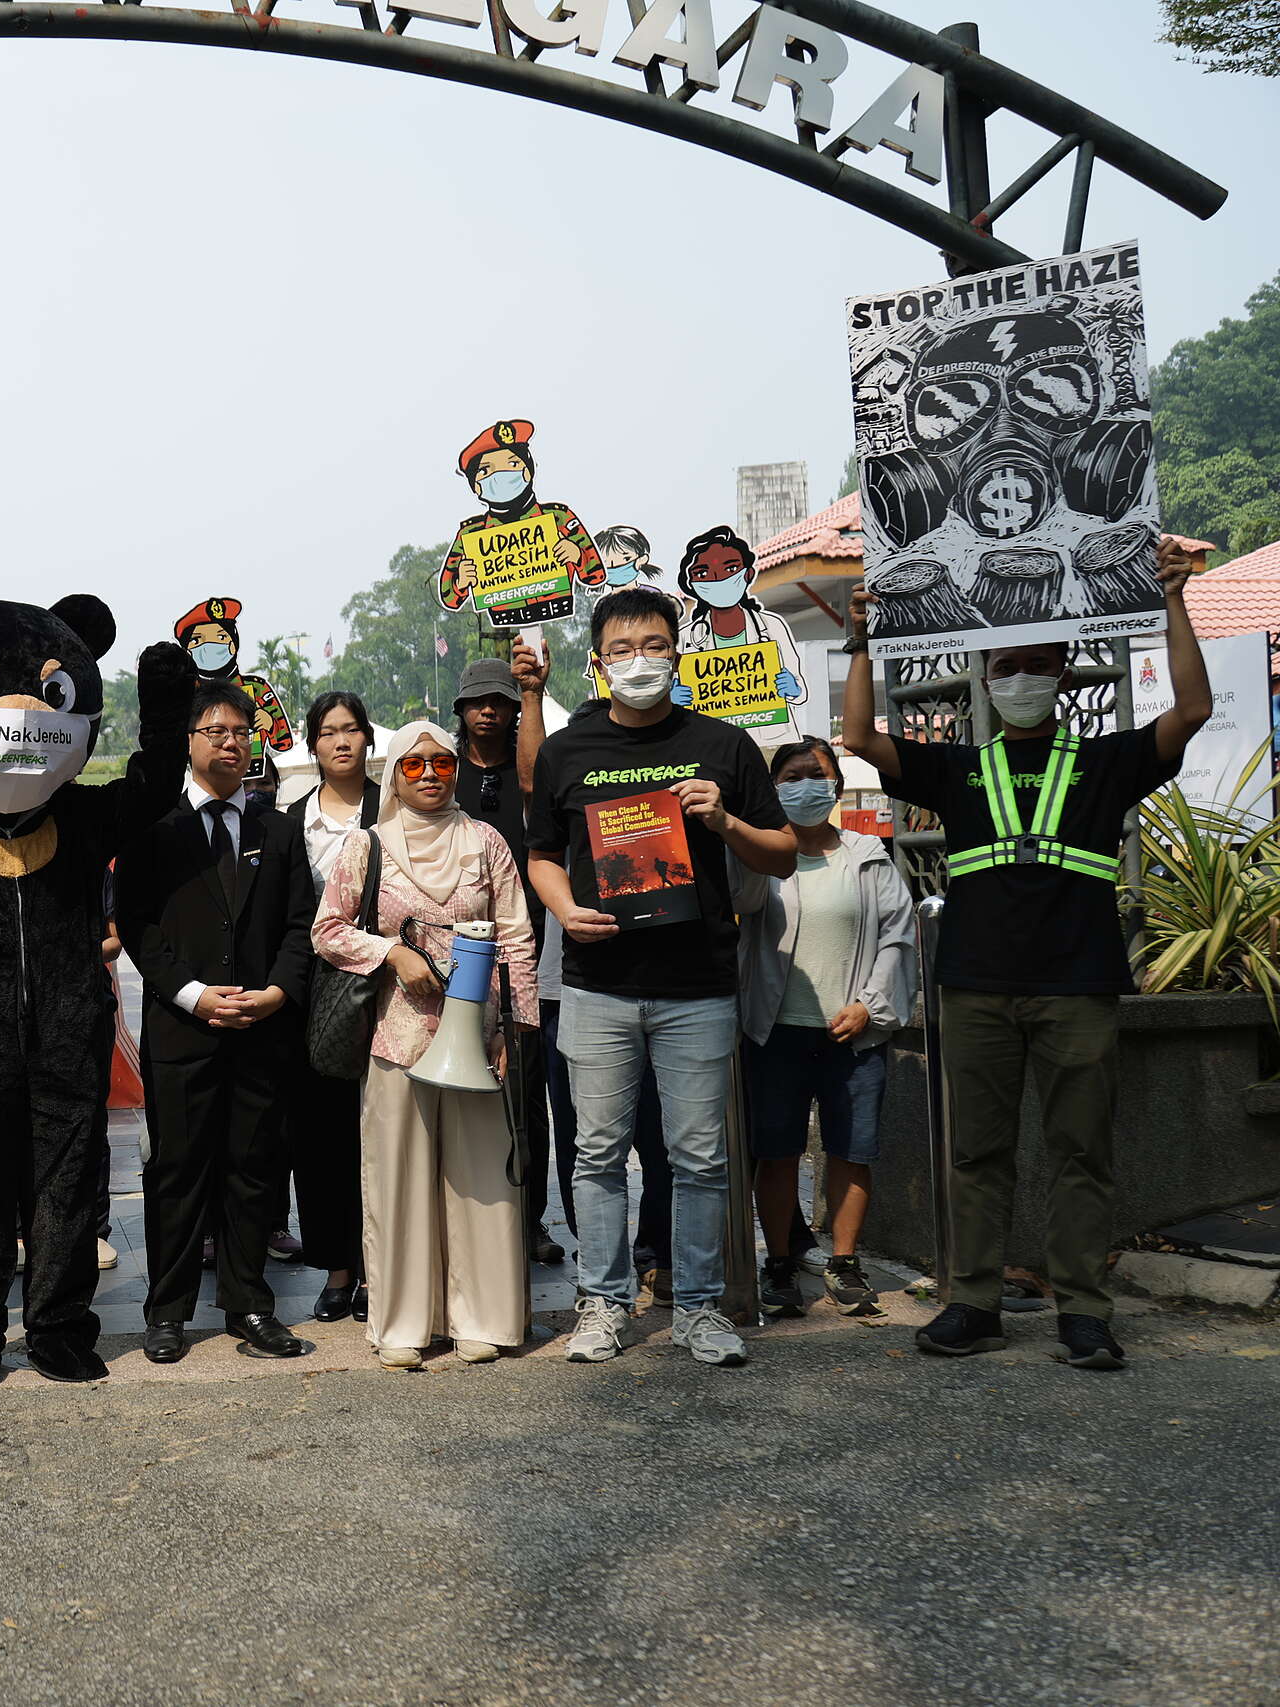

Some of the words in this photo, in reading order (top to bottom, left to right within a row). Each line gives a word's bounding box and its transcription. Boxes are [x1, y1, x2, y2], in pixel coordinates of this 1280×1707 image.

[333, 0, 944, 185] GARA
[851, 288, 944, 330] STOP
[953, 270, 1027, 309] THE
[1034, 246, 1140, 297] HAZE
[918, 360, 1012, 380] DEFORESTATION
[1026, 349, 1048, 362] THE
[478, 524, 545, 557] UDARA
[480, 573, 516, 590] UNTUK
[518, 561, 558, 579] SEMUA
[483, 579, 559, 605] GREENPEACE
[876, 637, 965, 655] #TakNakJerebu
[1078, 616, 1160, 635] GREENPEACE
[694, 650, 765, 680] UDARA
[692, 699, 732, 713] UNTUK
[734, 690, 777, 706] SEMUA
[721, 710, 777, 726] ENPEACE
[583, 762, 701, 788] GREENPEACE
[966, 771, 1085, 789] GRNPEE
[597, 809, 618, 819] When
[618, 806, 639, 816] Clean
[639, 802, 651, 811] Air
[599, 819, 607, 827] is
[607, 813, 644, 826] Sacrificed
[644, 811, 655, 819] for
[601, 825, 624, 836] Global
[624, 816, 671, 832] Commodities
